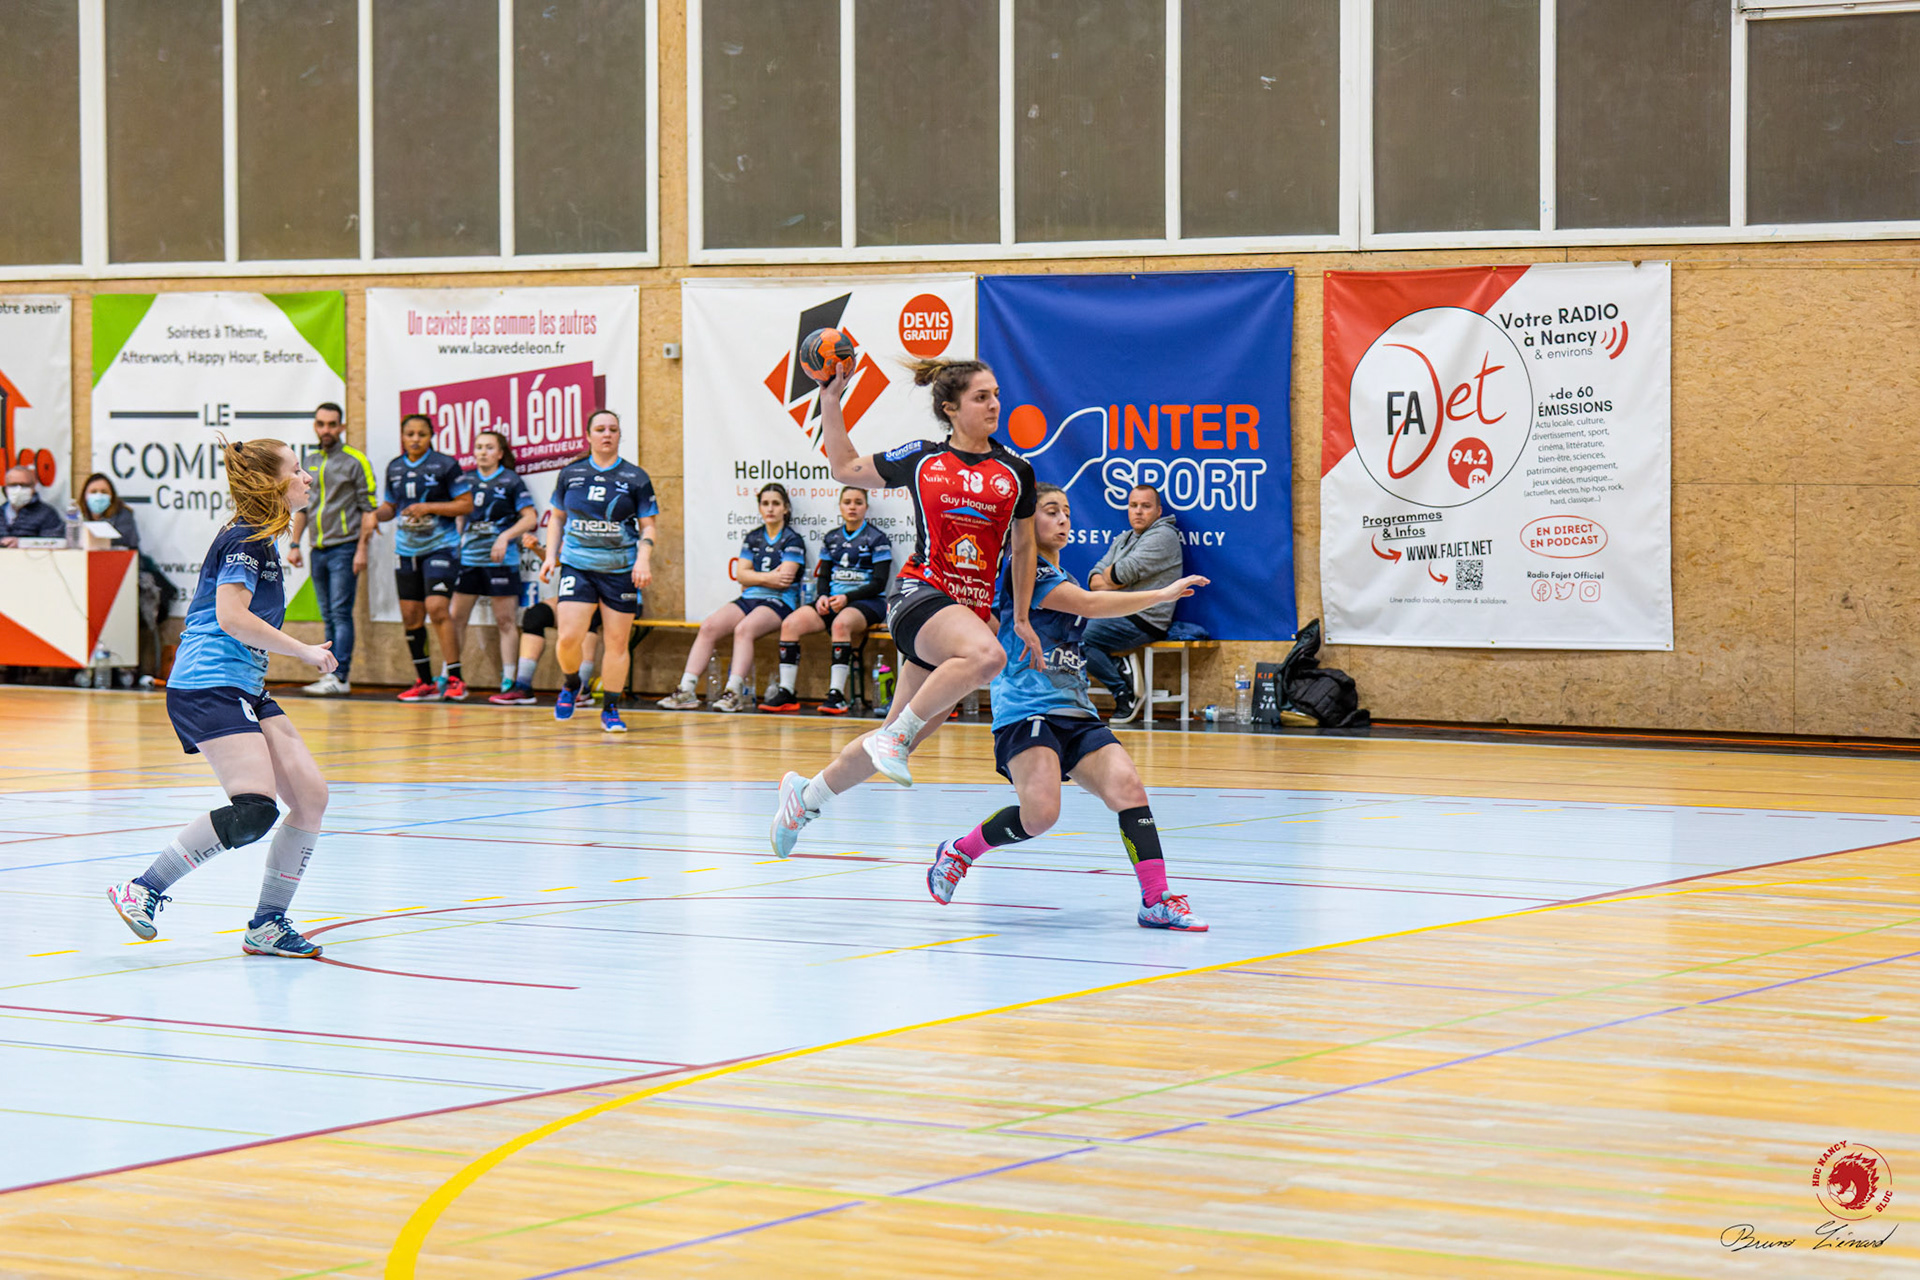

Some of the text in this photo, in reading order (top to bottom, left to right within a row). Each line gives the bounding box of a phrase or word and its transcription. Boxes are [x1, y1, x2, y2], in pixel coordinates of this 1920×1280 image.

[23, 302, 62, 315] avenir
[1499, 303, 1619, 329] Votre RADIO
[408, 309, 597, 339] Un caviste pas comme les autres
[903, 312, 949, 329] DEVIS
[167, 325, 211, 339] Soirées
[903, 329, 949, 341] GRATUIT
[1524, 330, 1597, 347] à Nancy
[438, 341, 565, 356] www.lacavedeleon.fr
[1535, 347, 1593, 360] & environs
[120, 351, 184, 365] Afterwork,
[187, 351, 226, 366] Happy
[229, 350, 260, 365] Hour,
[1577, 386, 1594, 399] 60
[204, 403, 230, 427] LE
[510, 374, 583, 447] Léon
[1538, 400, 1613, 417] ÉMISSIONS
[1108, 404, 1260, 451] INTER
[1535, 421, 1552, 429] Actu
[521, 439, 585, 458] SPIRITUEUX
[1451, 449, 1489, 465] 94.2
[734, 460, 834, 480] HelloHom
[957, 469, 983, 493] 18
[1102, 456, 1267, 512] SPORT
[1471, 475, 1485, 484] FM
[1532, 479, 1549, 488] jeux
[587, 485, 606, 501] 12
[736, 486, 749, 497] La
[811, 488, 838, 500] pour
[940, 493, 997, 513] Guy Hoquet
[1362, 511, 1443, 527] Programmes
[727, 530, 738, 540] et
[1382, 525, 1426, 538] & Infos
[1536, 524, 1593, 536] EN DIRECT
[1530, 535, 1598, 548] EN PODCAST
[1406, 540, 1493, 561] WWW.FAJET.NET
[761, 557, 772, 572] 2
[840, 553, 849, 568] 4
[1527, 571, 1604, 580] Radio Fajet Officiel
[558, 576, 576, 597] 12
